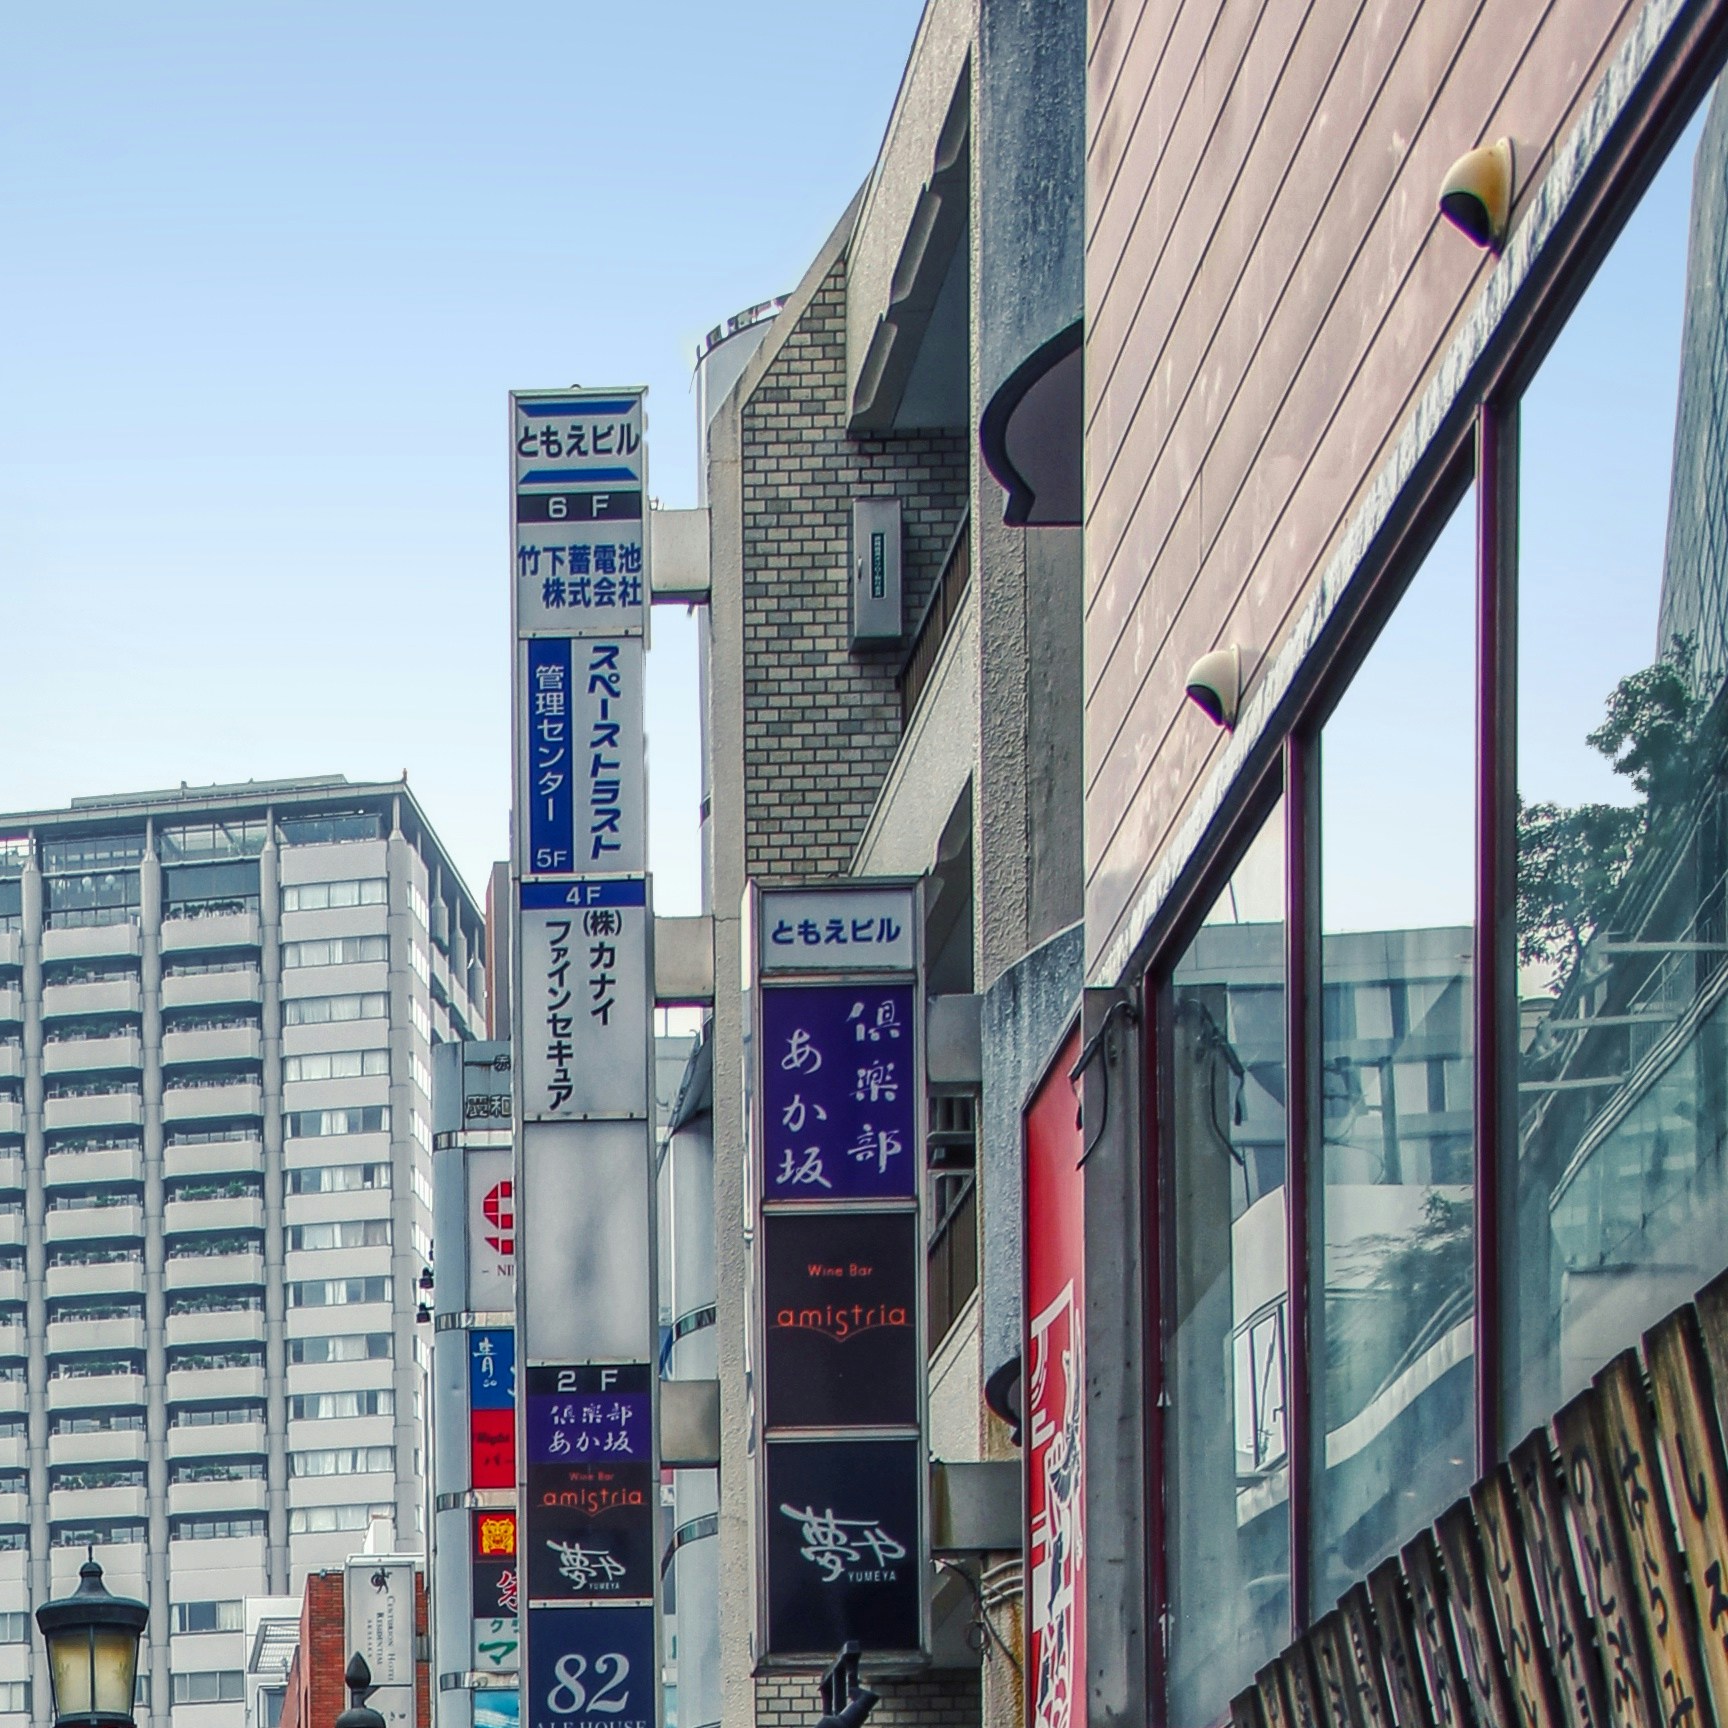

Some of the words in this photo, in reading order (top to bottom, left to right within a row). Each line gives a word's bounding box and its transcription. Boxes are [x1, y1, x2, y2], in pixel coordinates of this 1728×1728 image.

[517, 423, 641, 459] ともえビル
[517, 543, 643, 579] 竹下蓄電池
[542, 575, 643, 609] 株式会社
[535, 664, 566, 823] 管理センター
[587, 643, 622, 862] スペーストラスト
[536, 848, 567, 870] 5F
[565, 886, 602, 905] 4F
[770, 916, 902, 947] ともえビル
[544, 919, 575, 1112] ファインセキュア
[776, 1028, 833, 1190] あか坂
[807, 1262, 844, 1278] Wine
[848, 1262, 874, 1278] Bar
[776, 1302, 907, 1338] amistria
[547, 1430, 634, 1455] あか坂
[569, 1471, 595, 1482] Wine
[598, 1471, 615, 1482] Bar
[542, 1487, 643, 1514] amistria
[848, 1569, 898, 1583] YUMEYA
[547, 1652, 630, 1714] 82
